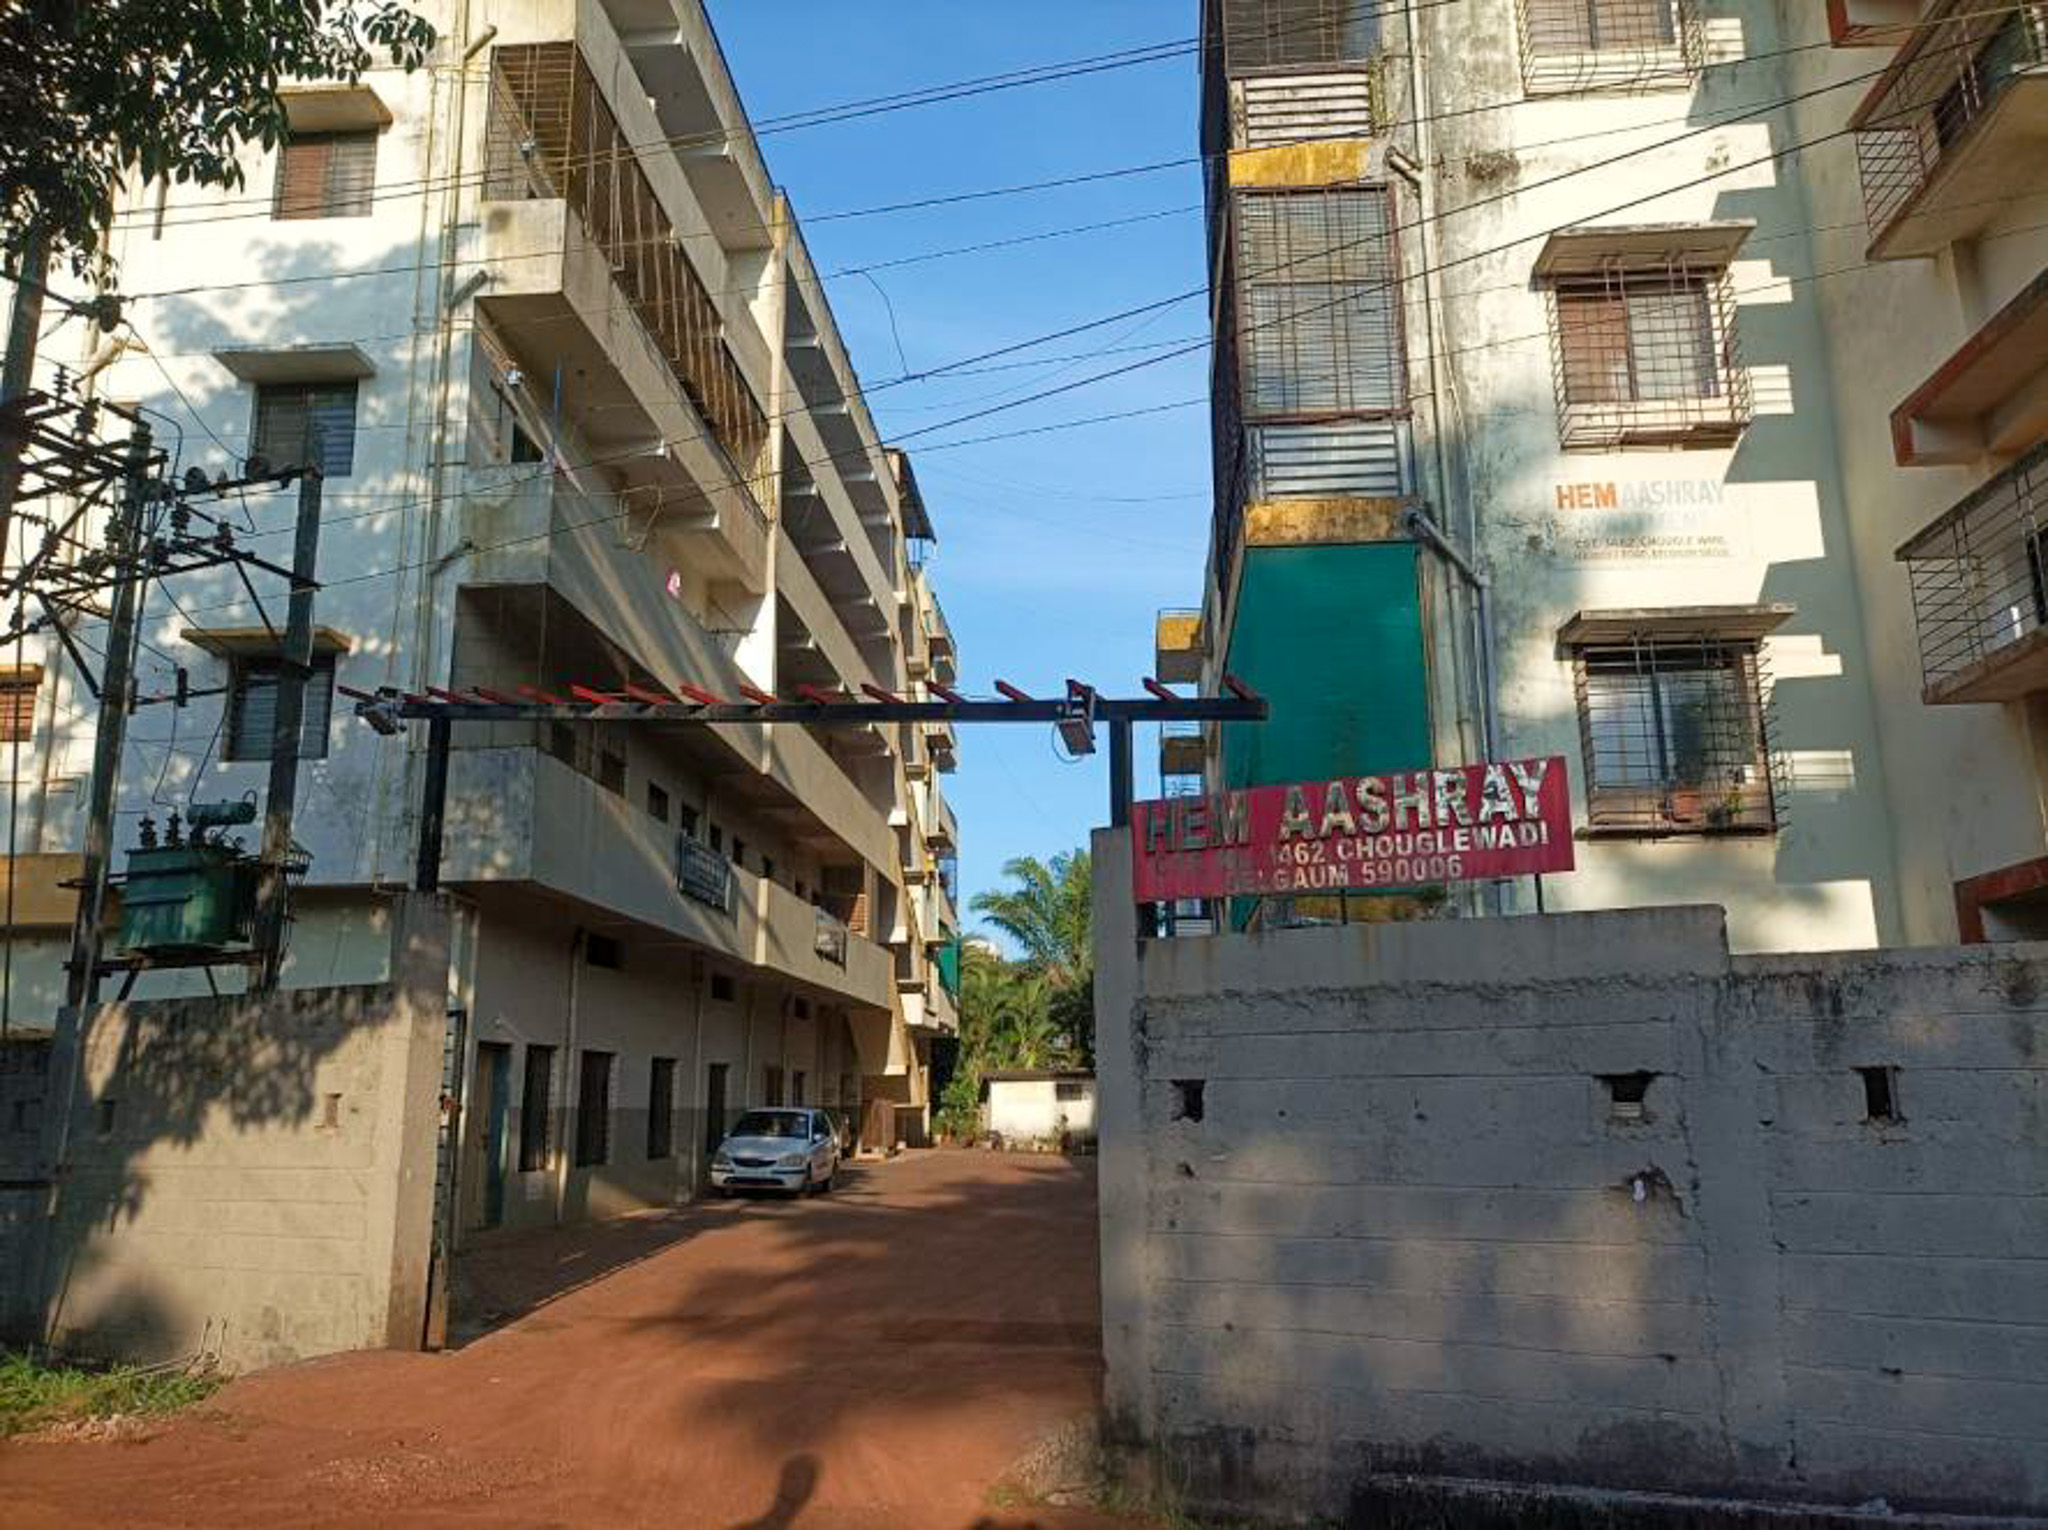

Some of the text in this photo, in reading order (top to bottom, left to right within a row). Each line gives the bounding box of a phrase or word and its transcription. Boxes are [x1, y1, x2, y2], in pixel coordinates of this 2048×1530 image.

[1556, 481, 1725, 510] HEM AASHRAY
[1146, 761, 1548, 853] HEM AASHRAY
[1336, 822, 1550, 861] CHOUGLEWADI
[1360, 853, 1464, 886] 590006
